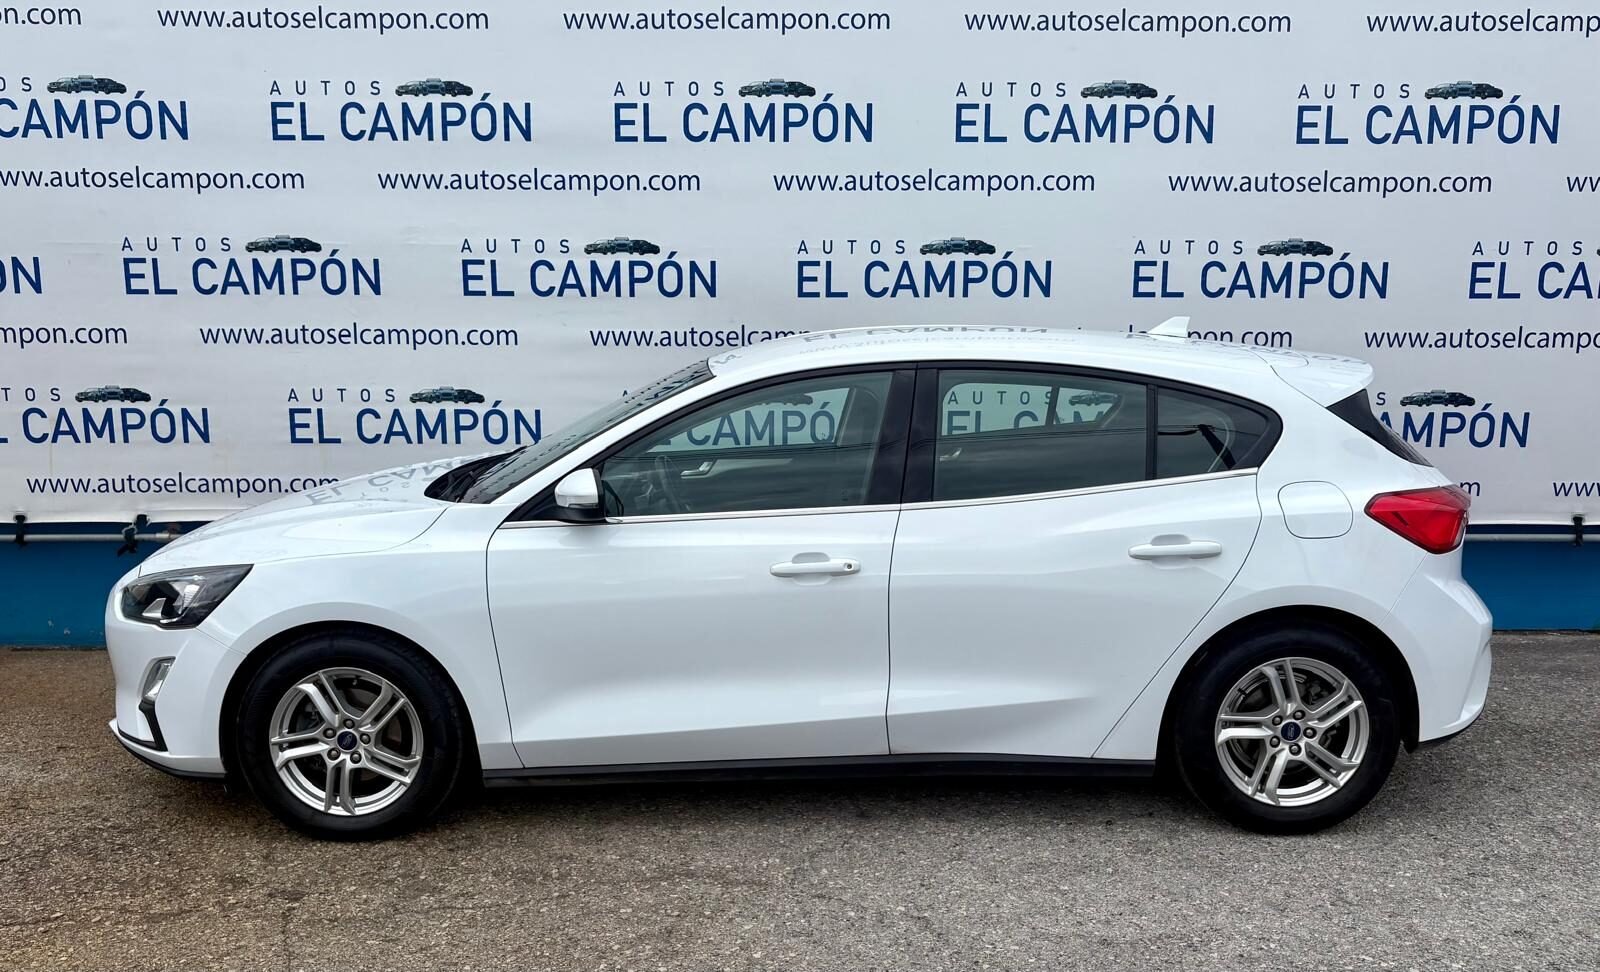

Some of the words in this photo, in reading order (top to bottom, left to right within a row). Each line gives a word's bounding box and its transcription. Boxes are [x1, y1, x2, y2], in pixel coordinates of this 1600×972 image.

[157, 5, 489, 35] www.autoselcampon.com
[563, 5, 890, 36] www.autoselcampon.com
[964, 7, 1291, 38] www.autoselcampon.com
[269, 80, 381, 96] AUTOS
[613, 81, 724, 97] AUTOS
[955, 81, 1066, 98] AUTOS
[1297, 83, 1410, 99] AUTOS
[270, 101, 325, 141] EL
[340, 92, 532, 142] CAMPÓN
[614, 102, 667, 143] EL
[682, 93, 873, 143] CAMPÓN
[955, 103, 1008, 143] EL
[1023, 94, 1215, 144] CAMPÓN
[1295, 105, 1349, 145] EL
[1365, 94, 1561, 145] CAMPÓN
[377, 167, 700, 197] www.autoselcampon.com
[773, 168, 1095, 197] www.autoselcampon.com
[1168, 169, 1492, 199] www.autoselcampon.com
[121, 236, 231, 252] AUTOS
[460, 238, 570, 254] AUTOS
[797, 239, 906, 255] AUTOS
[1134, 239, 1243, 255] AUTOS
[1471, 240, 1583, 256] AUTOS
[122, 257, 178, 296] EL
[191, 249, 382, 296] CAMPÓN
[461, 259, 515, 297] EL
[529, 250, 717, 298] CAMPÓN
[797, 260, 849, 298] EL
[864, 250, 1052, 299] CAMPÓN
[1132, 260, 1185, 298] EL
[1200, 252, 1389, 300] CAMPÓN
[1468, 261, 1521, 300] EL
[1537, 261, 1600, 300] CA
[199, 321, 518, 351] www.autoselcampon.com
[287, 387, 396, 403] AUTOS
[21, 399, 211, 444] CAMPÓN
[288, 407, 342, 445] EL
[356, 399, 542, 446] CAMPÓN
